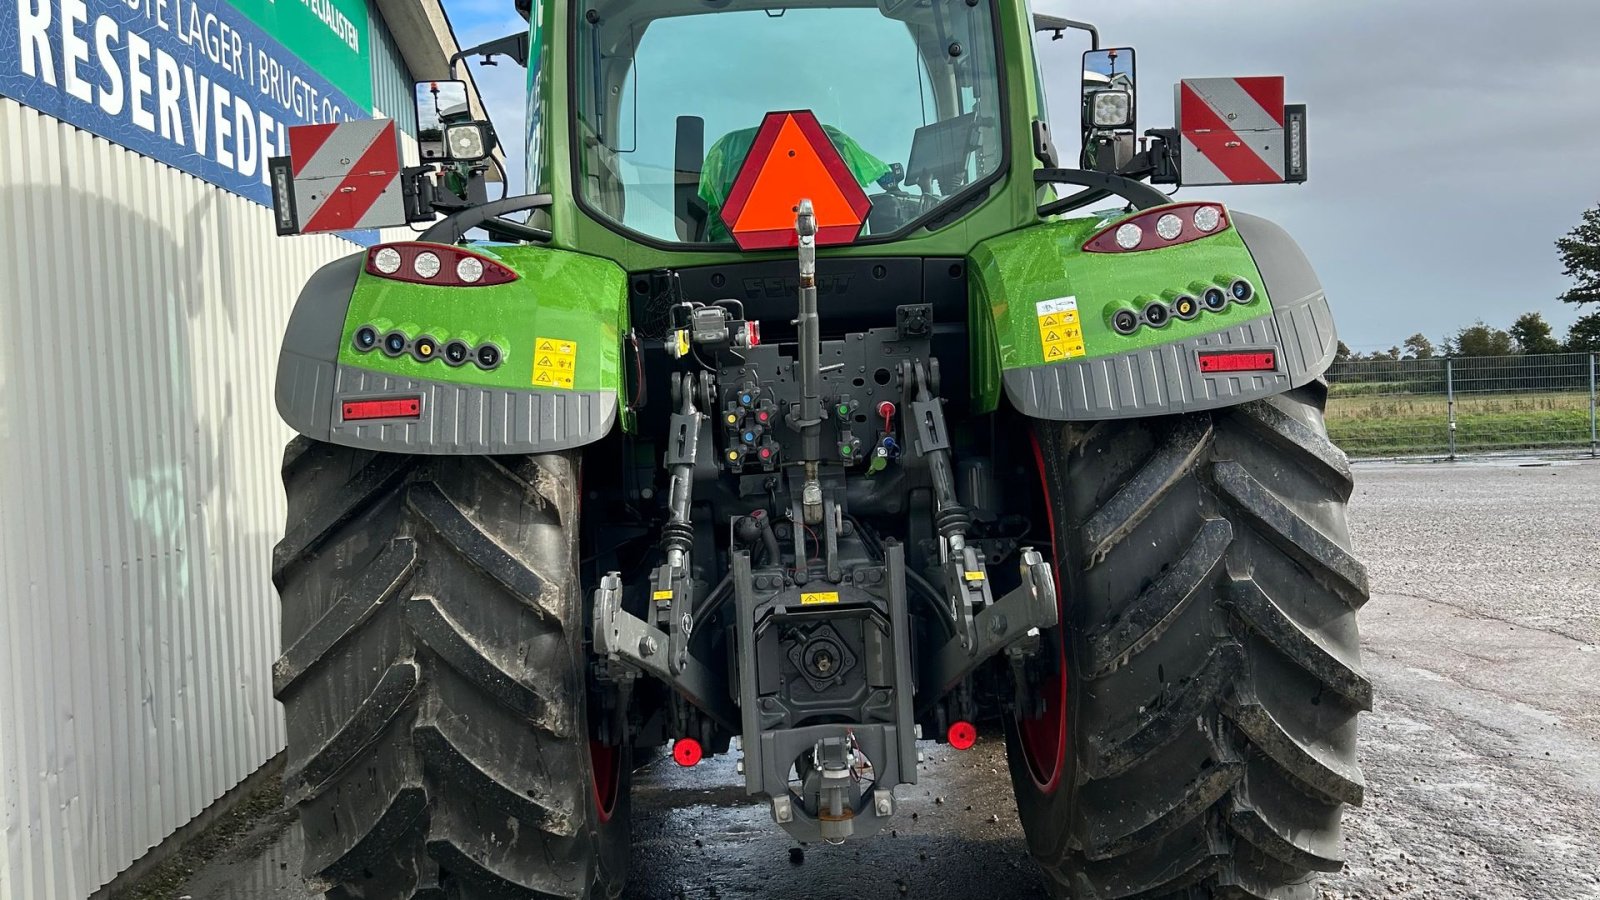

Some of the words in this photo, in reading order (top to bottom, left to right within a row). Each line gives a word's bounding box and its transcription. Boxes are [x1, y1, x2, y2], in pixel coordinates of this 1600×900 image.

[176, 0, 245, 80] LAGER
[248, 42, 254, 87] I
[259, 49, 318, 125] BRUGTE
[301, 0, 359, 55] ECIALISTEN
